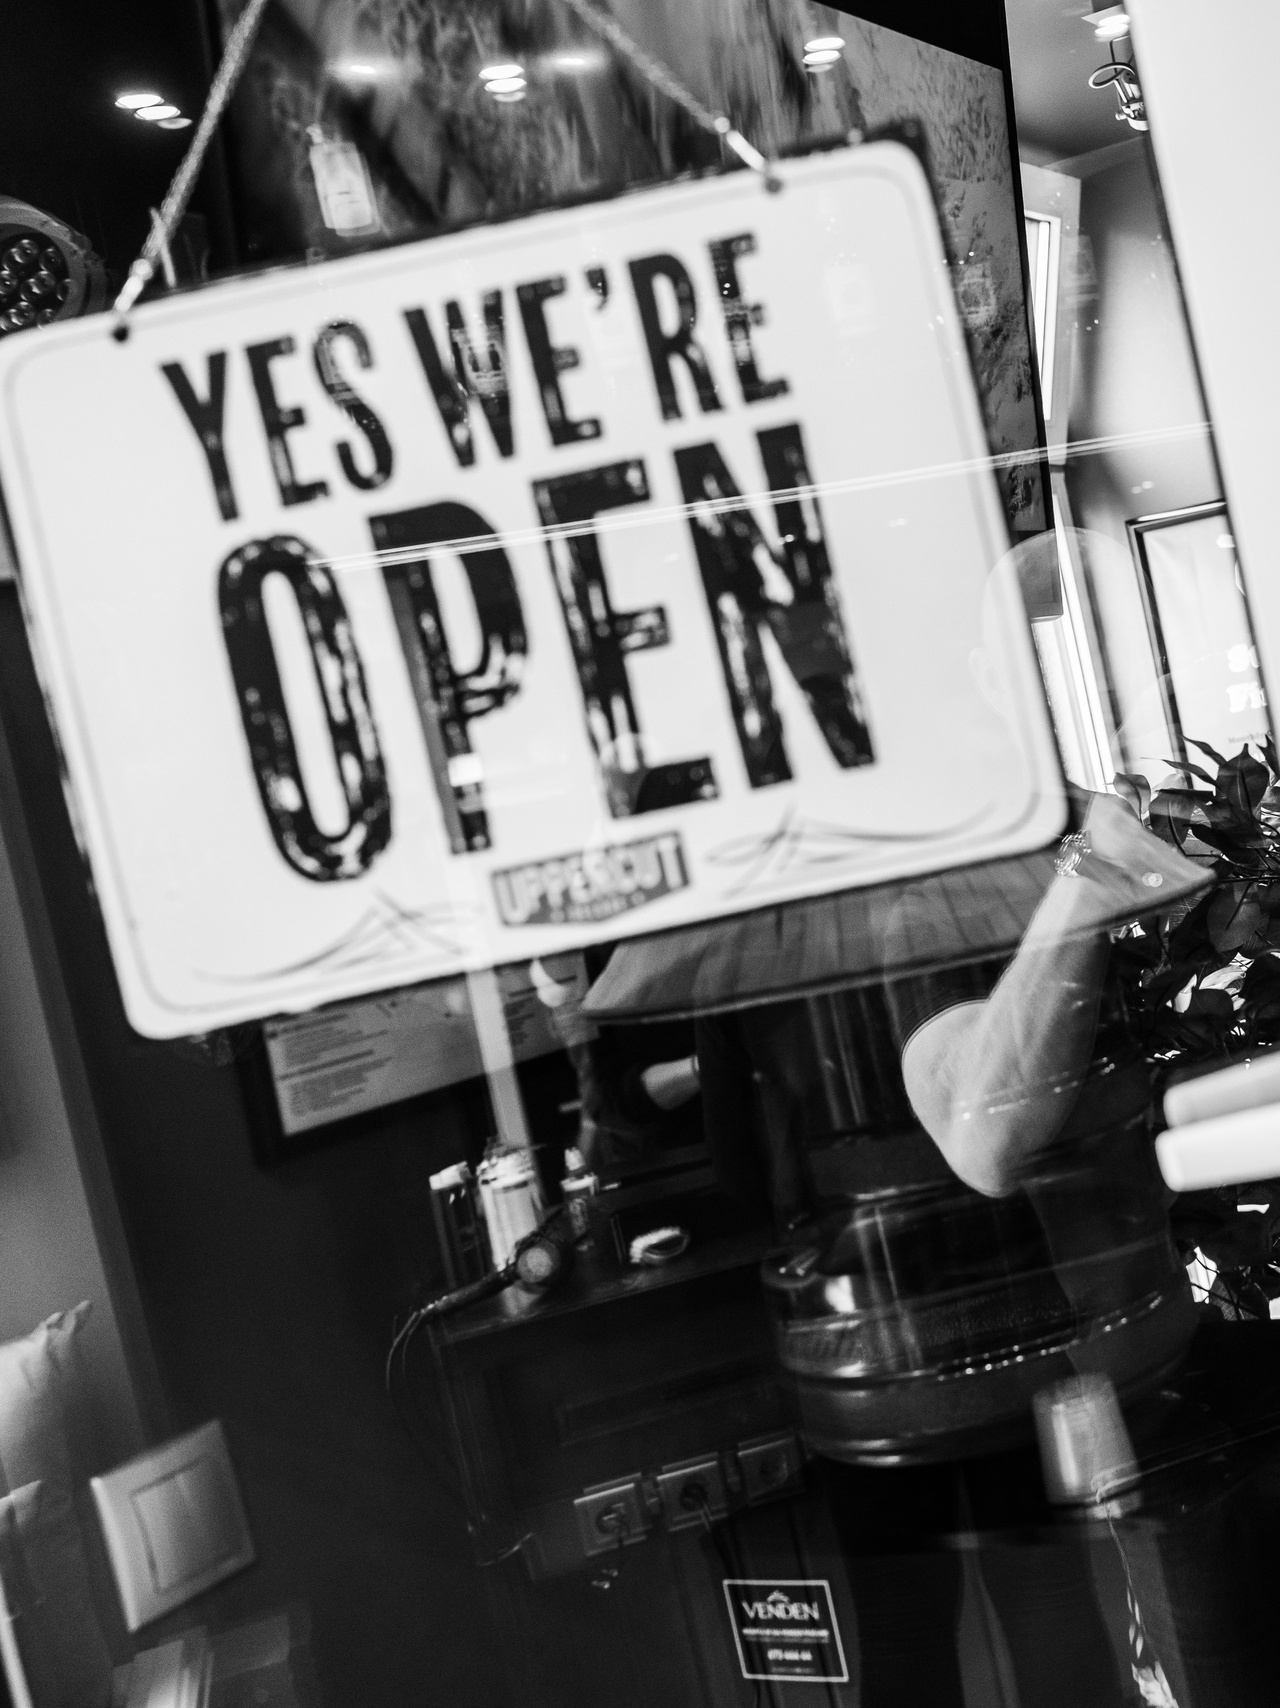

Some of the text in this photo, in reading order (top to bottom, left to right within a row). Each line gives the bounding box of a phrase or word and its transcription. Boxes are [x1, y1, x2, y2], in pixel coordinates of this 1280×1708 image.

[160, 231, 791, 522] YES WE'RE
[218, 421, 877, 883] OPEN
[742, 1601, 819, 1620] VENDEN
